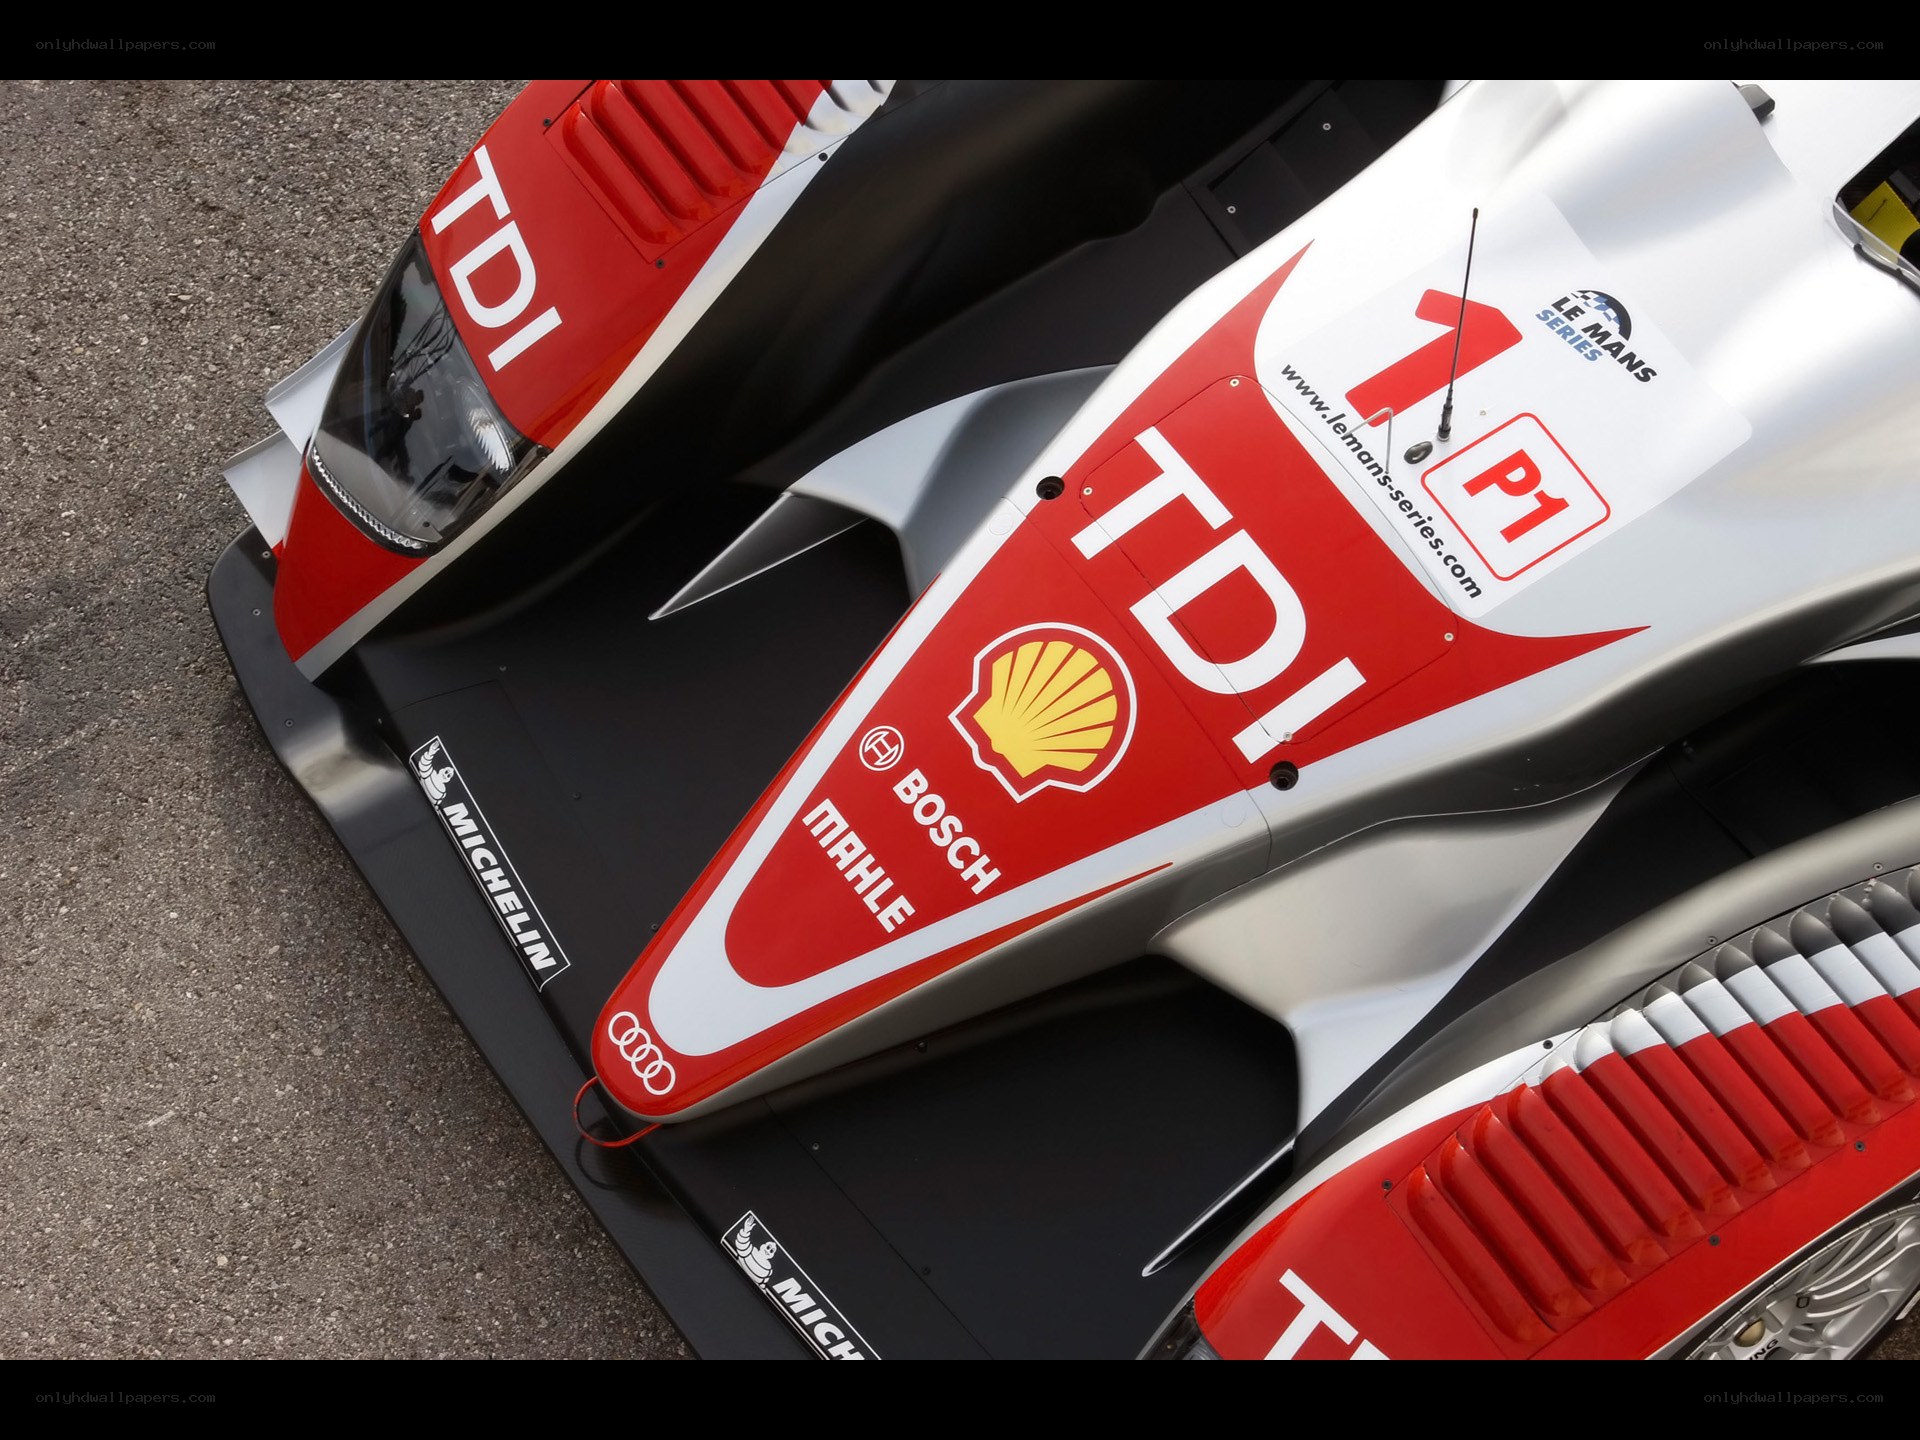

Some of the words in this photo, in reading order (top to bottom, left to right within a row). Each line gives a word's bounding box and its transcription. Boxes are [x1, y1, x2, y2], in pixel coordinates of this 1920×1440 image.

[430, 144, 563, 372] TDI
[1345, 288, 1524, 428] 1
[1535, 309, 1604, 362] SERIES
[1551, 296, 1586, 322] LE
[1581, 322, 1658, 383] MANS
[1281, 363, 1483, 600] www.lemans-series.com
[1461, 447, 1571, 544] P1
[1070, 425, 1367, 764] TDI
[443, 802, 557, 971] MICHELIN
[802, 798, 916, 934] MAHLE
[892, 768, 1002, 895] BOSCH
[1263, 1268, 1391, 1360] T
